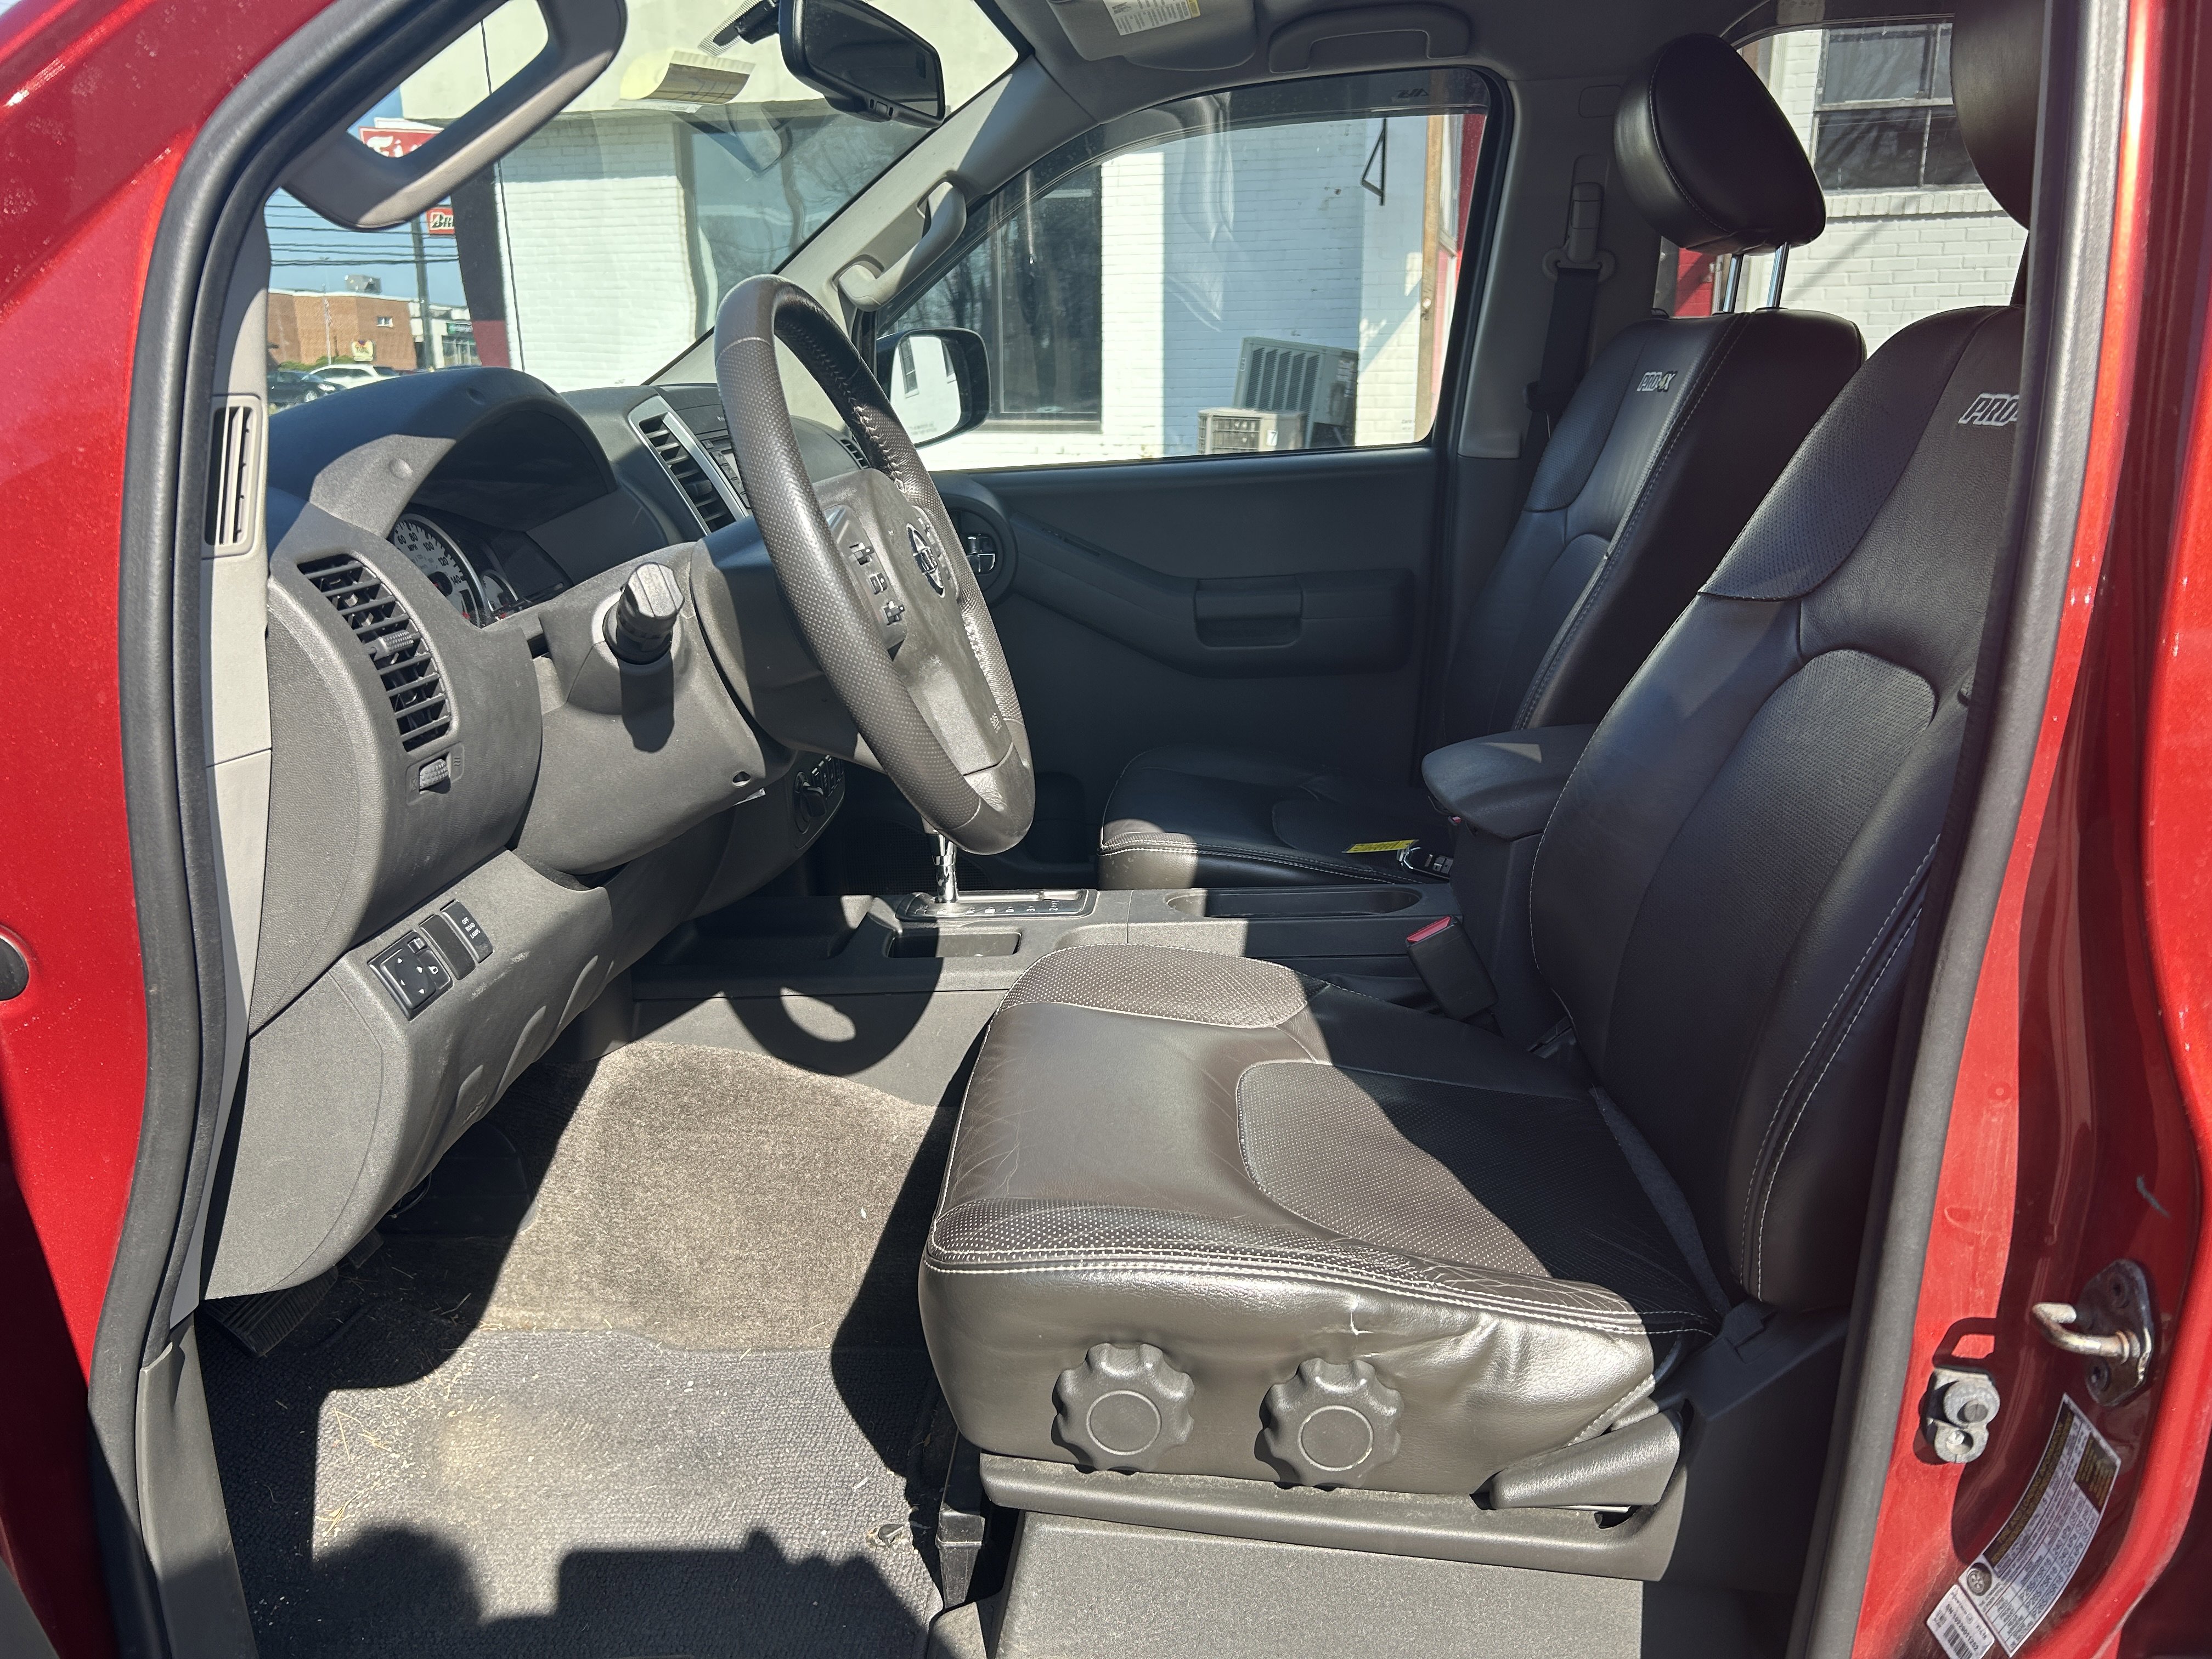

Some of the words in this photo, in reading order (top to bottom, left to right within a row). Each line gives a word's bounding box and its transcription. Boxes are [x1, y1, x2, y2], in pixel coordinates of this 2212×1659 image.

[397, 534, 407, 545] 60
[409, 532, 419, 542] 80
[408, 543, 419, 551] MPH
[423, 541, 435, 552] 100
[438, 556, 449, 567] 120
[450, 574, 462, 586] 140
[461, 917, 470, 925] OFF
[465, 922, 476, 932] ROAD
[470, 928, 481, 939] LAMPS
